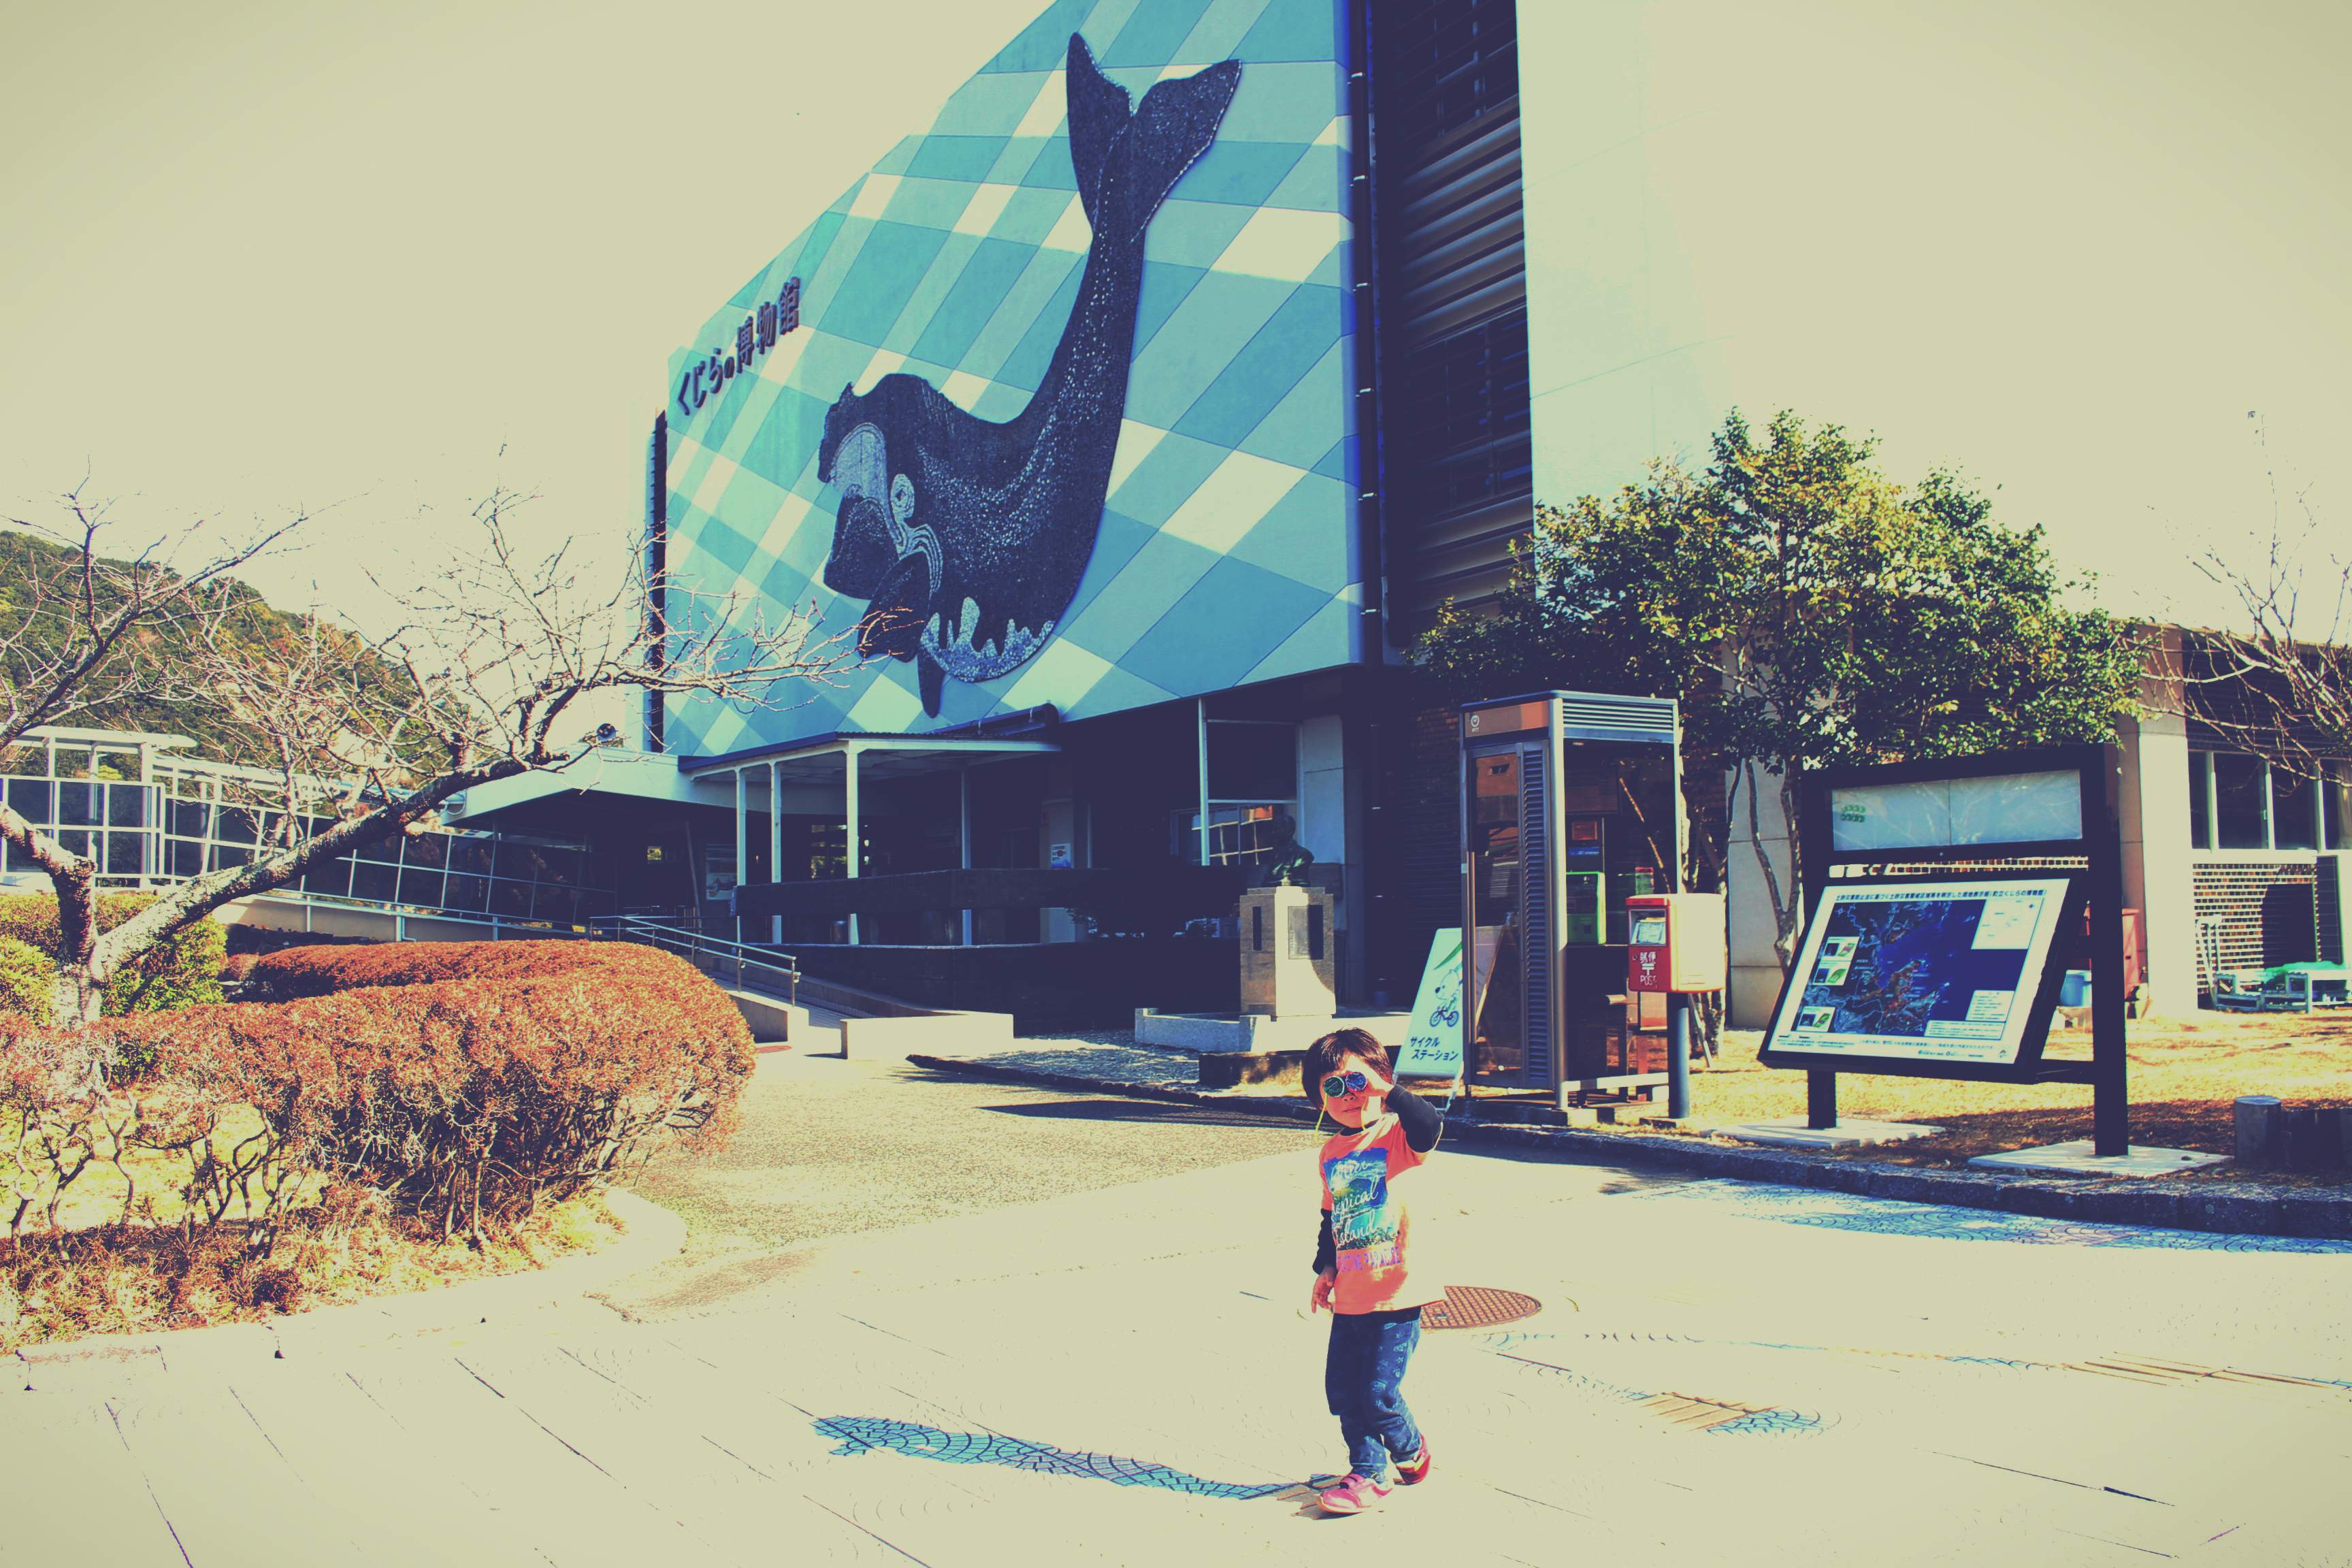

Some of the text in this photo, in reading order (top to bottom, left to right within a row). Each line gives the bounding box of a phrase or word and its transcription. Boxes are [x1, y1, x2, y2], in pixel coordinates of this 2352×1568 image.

[676, 276, 800, 416] くじらの博物館
[1640, 975, 1657, 986] POST
[1410, 1036, 1440, 1047] サイクル
[1411, 1049, 1458, 1061] ステーション
